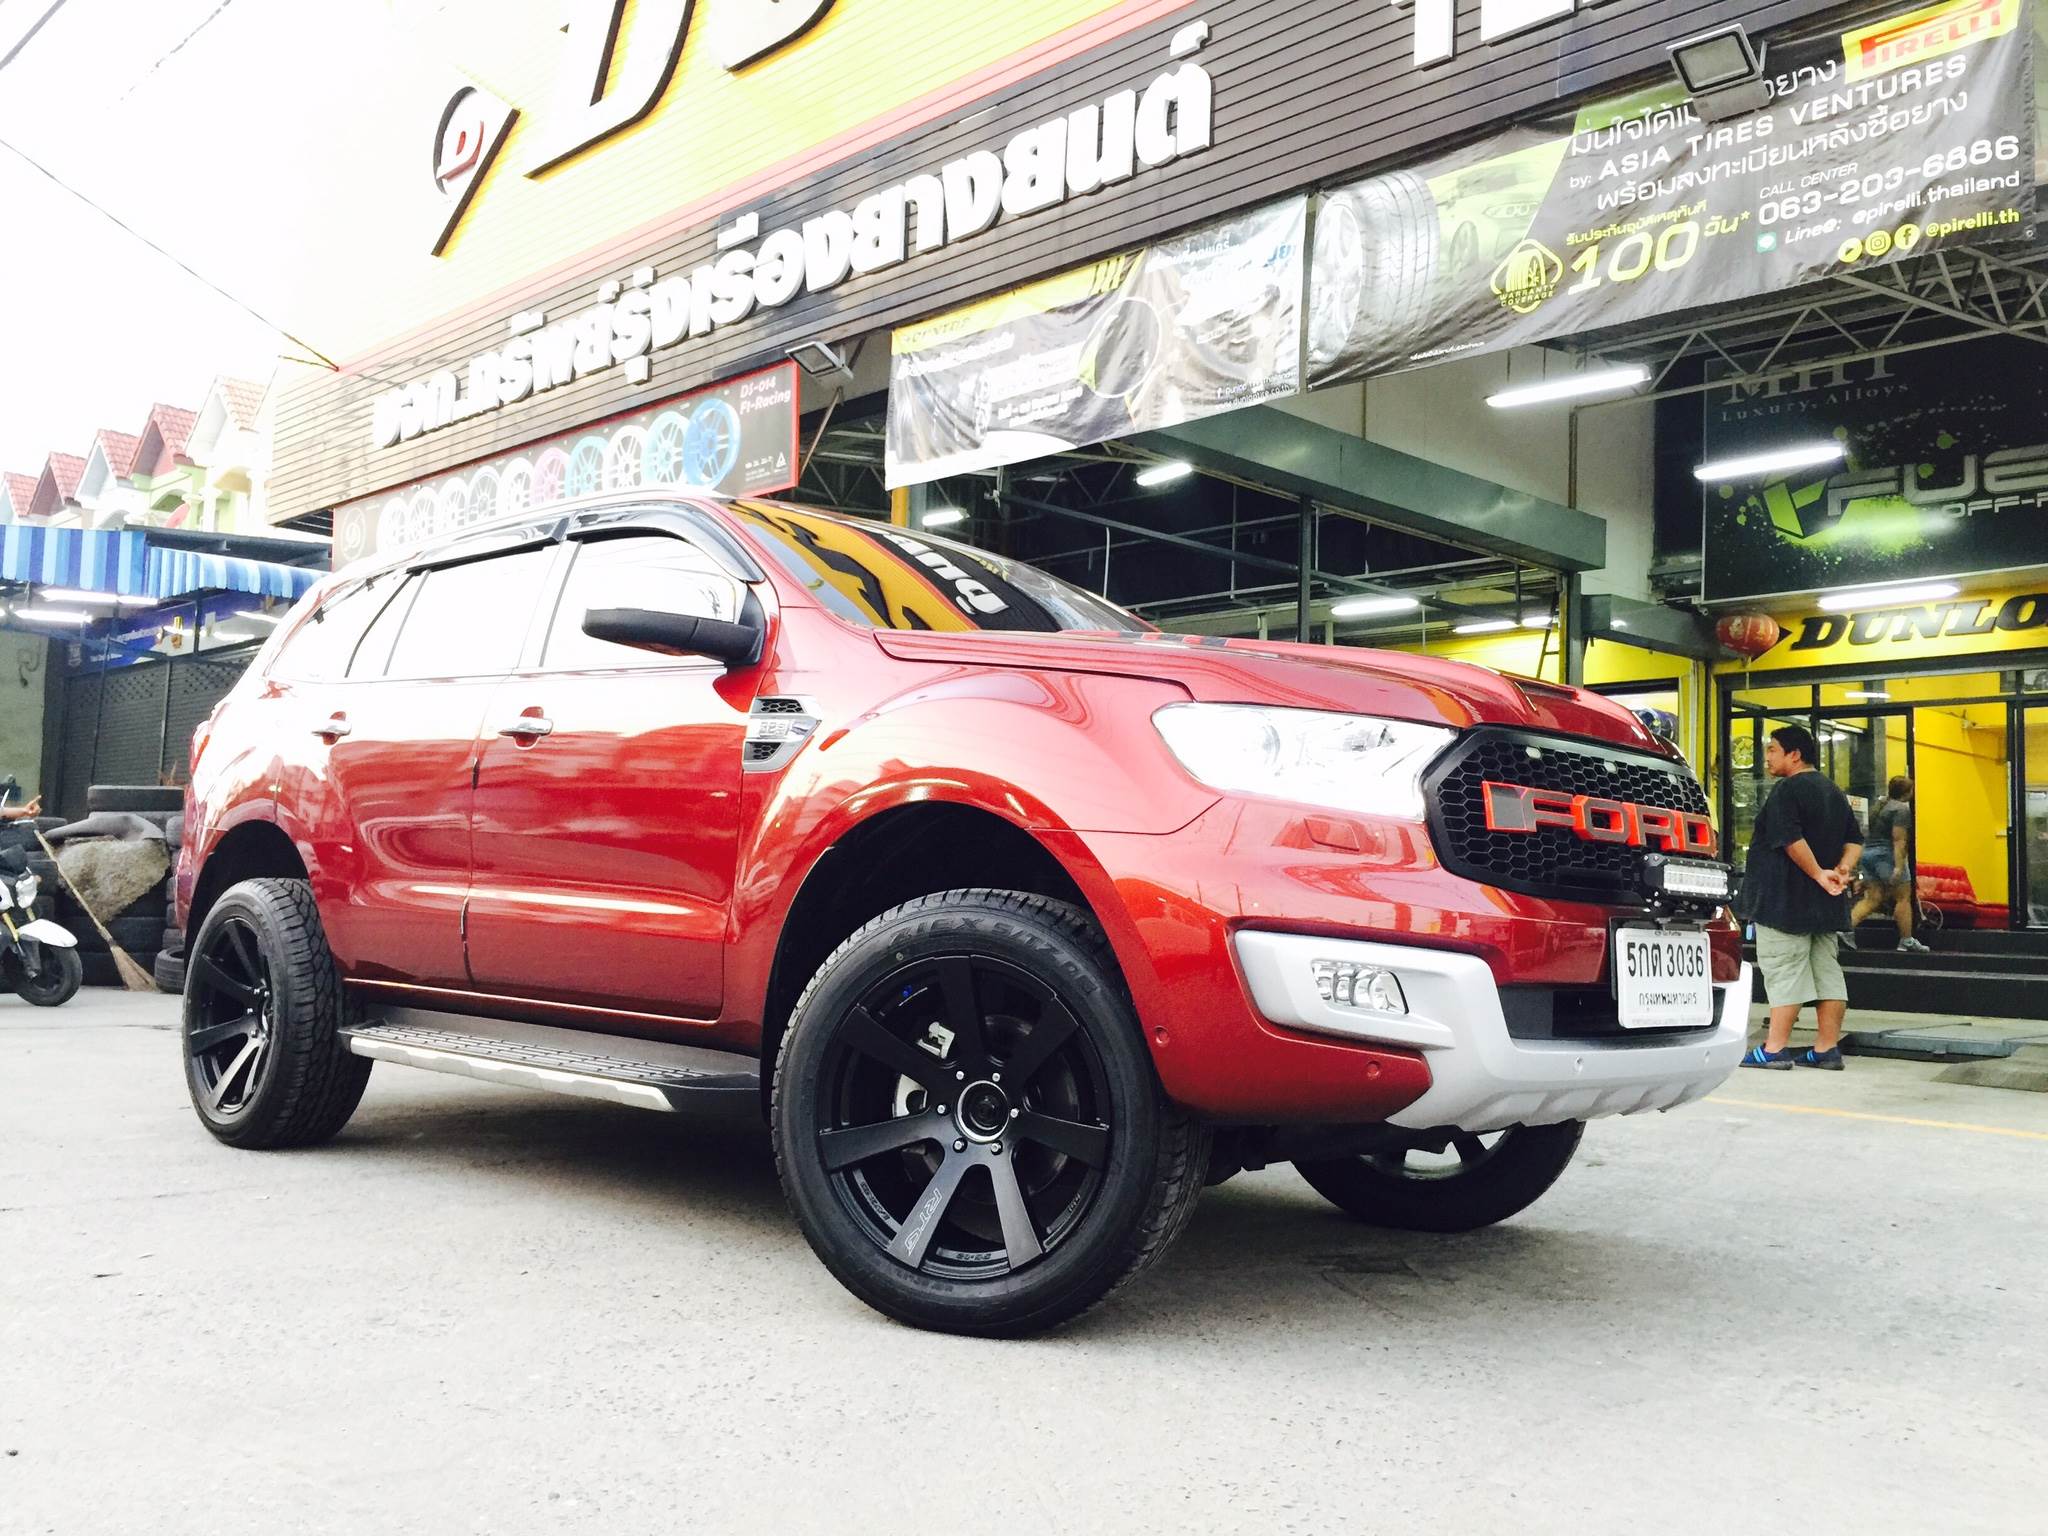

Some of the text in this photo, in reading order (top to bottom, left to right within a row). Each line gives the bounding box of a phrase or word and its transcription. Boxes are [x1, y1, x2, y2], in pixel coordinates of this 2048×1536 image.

[1860, 0, 2001, 68] PIRELLI
[1569, 54, 1968, 189] by: ASIA TIRES VENTURES
[1758, 135, 2020, 226] 063-203-6886
[1759, 163, 1858, 199] CALL CENTER
[1852, 170, 2020, 226] @pirelli.thailand
[1925, 208, 2020, 238] @pirelli.th
[1567, 221, 1701, 296] 100
[1499, 284, 1555, 301] WARRANTY
[1500, 291, 1554, 307] COVERAGE
[1825, 384, 1909, 407] Alloys
[1790, 592, 2048, 650] DUNLO
[1482, 781, 1719, 858] FORD
[1666, 944, 1704, 978] 3036
